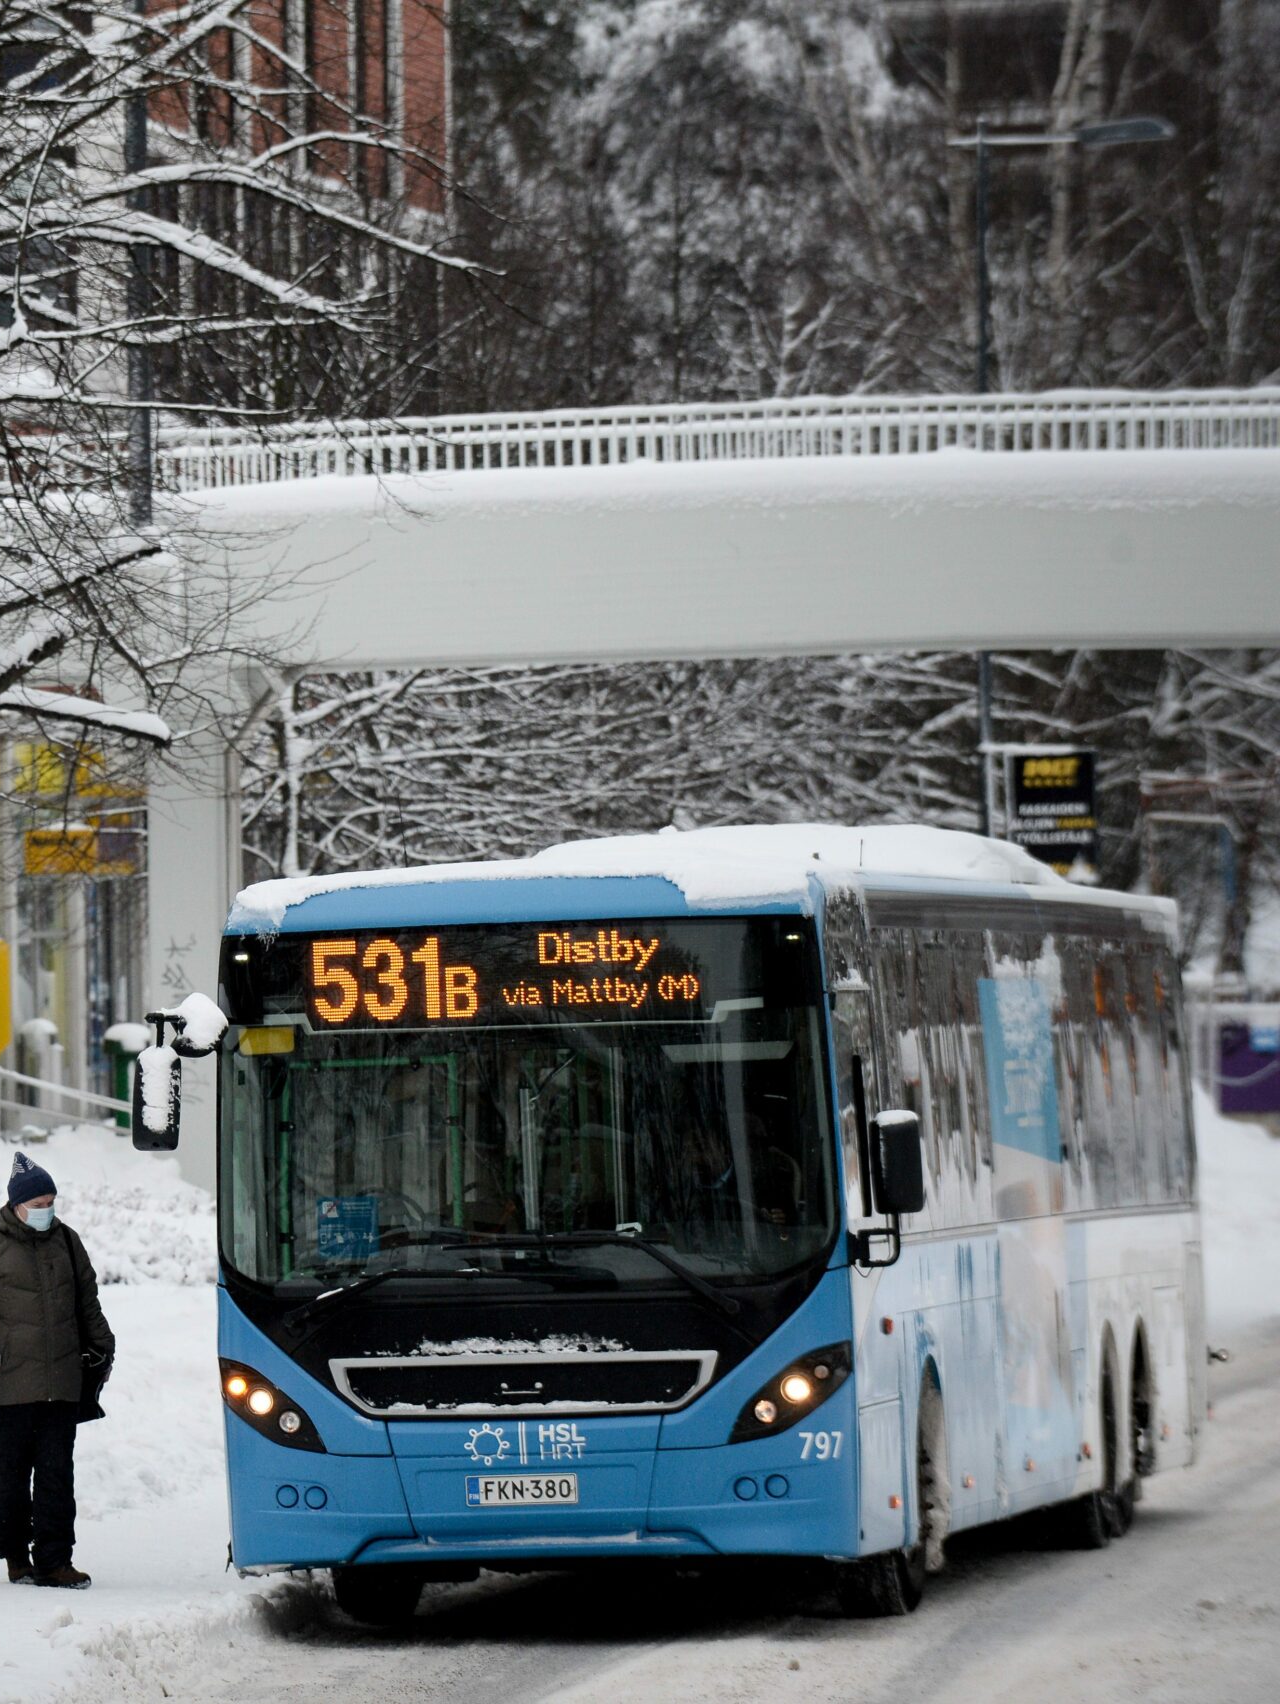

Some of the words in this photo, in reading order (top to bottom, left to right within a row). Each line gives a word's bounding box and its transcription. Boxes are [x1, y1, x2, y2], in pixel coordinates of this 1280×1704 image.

[537, 930, 661, 972] Distby
[502, 981, 542, 1007] via
[552, 976, 649, 1008] Mattby
[657, 973, 700, 1002] (M)
[538, 1423, 587, 1443] HSL
[798, 1431, 844, 1460] 797
[539, 1442, 587, 1461] HRT
[483, 1478, 572, 1501] FKN-380
